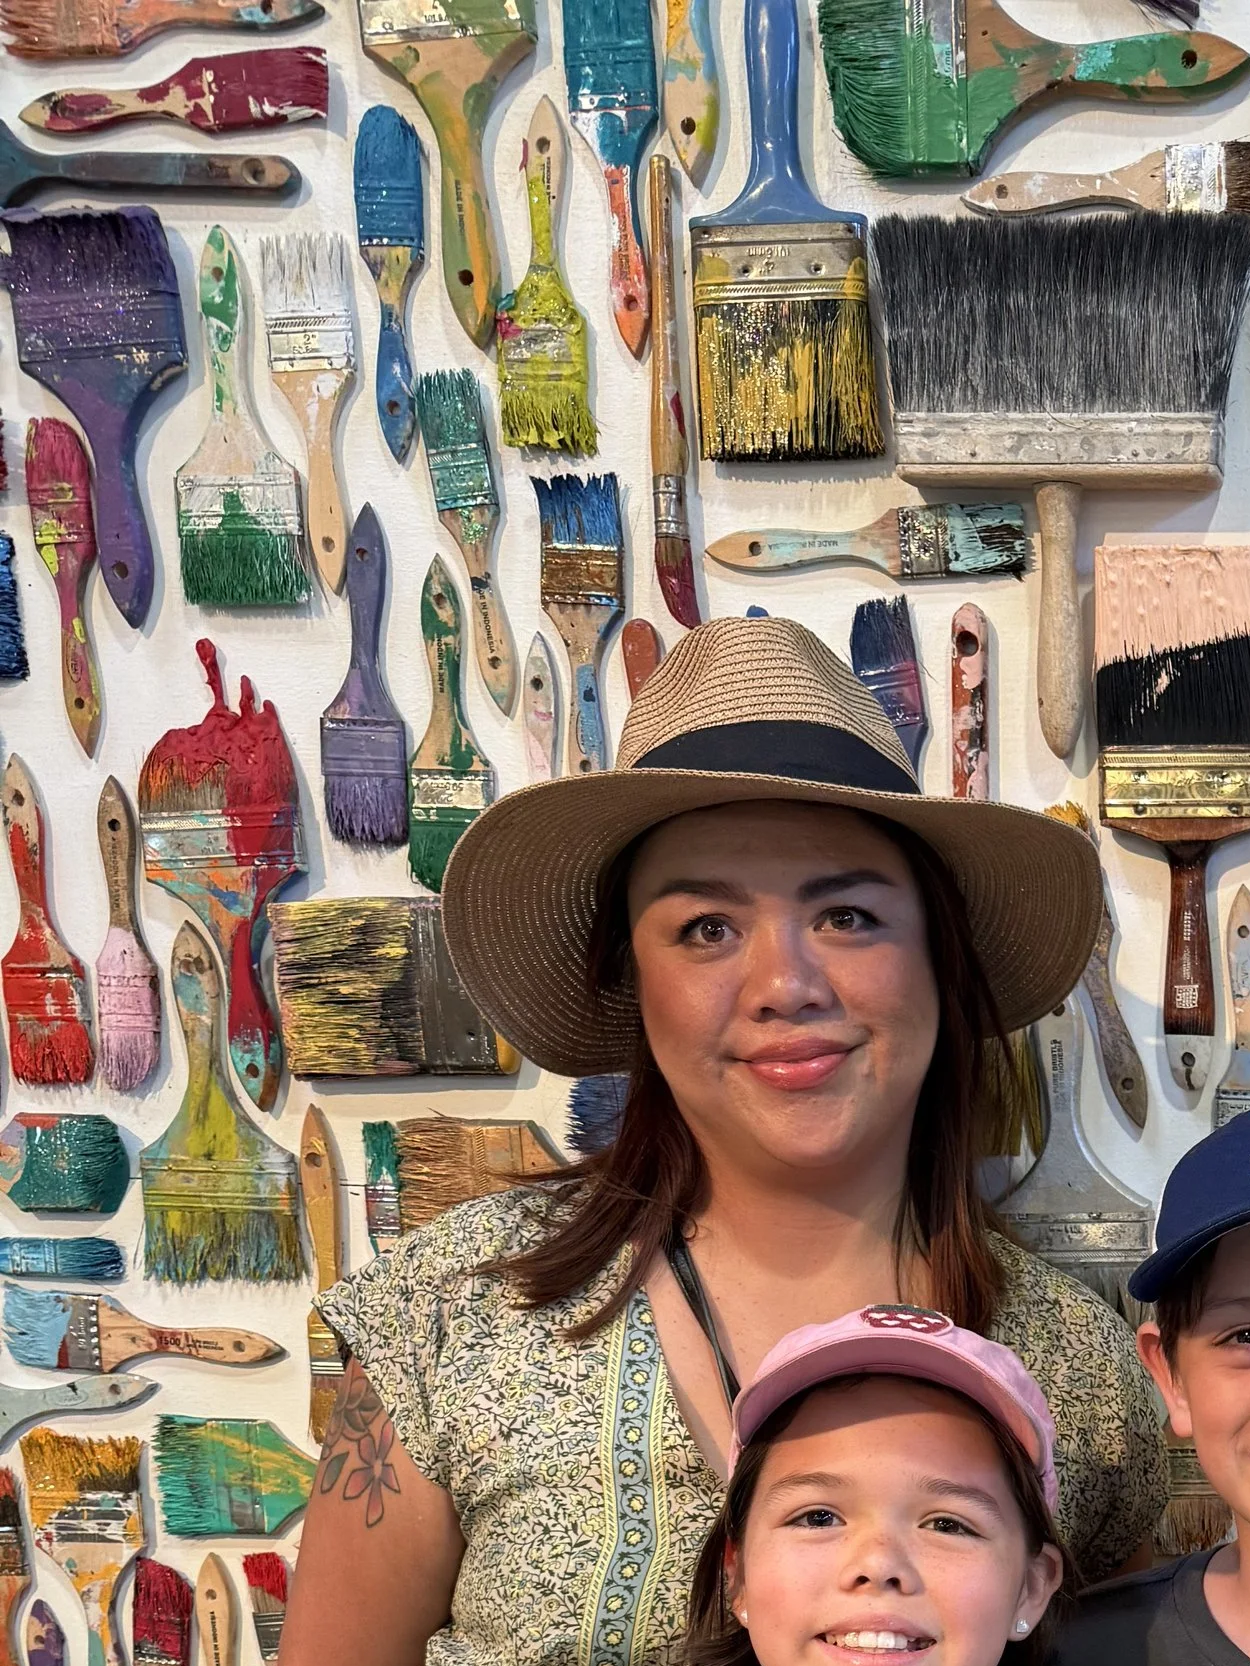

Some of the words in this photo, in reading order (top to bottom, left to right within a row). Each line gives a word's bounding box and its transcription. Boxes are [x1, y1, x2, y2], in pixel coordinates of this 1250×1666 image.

[815, 540, 839, 548] MADE
[482, 611, 495, 654] INDONESIA
[437, 672, 445, 693] MADE
[1183, 911, 1192, 941] JACKSON
[158, 1335, 181, 1347] 1500
[209, 1610, 218, 1643] INDONESIA
